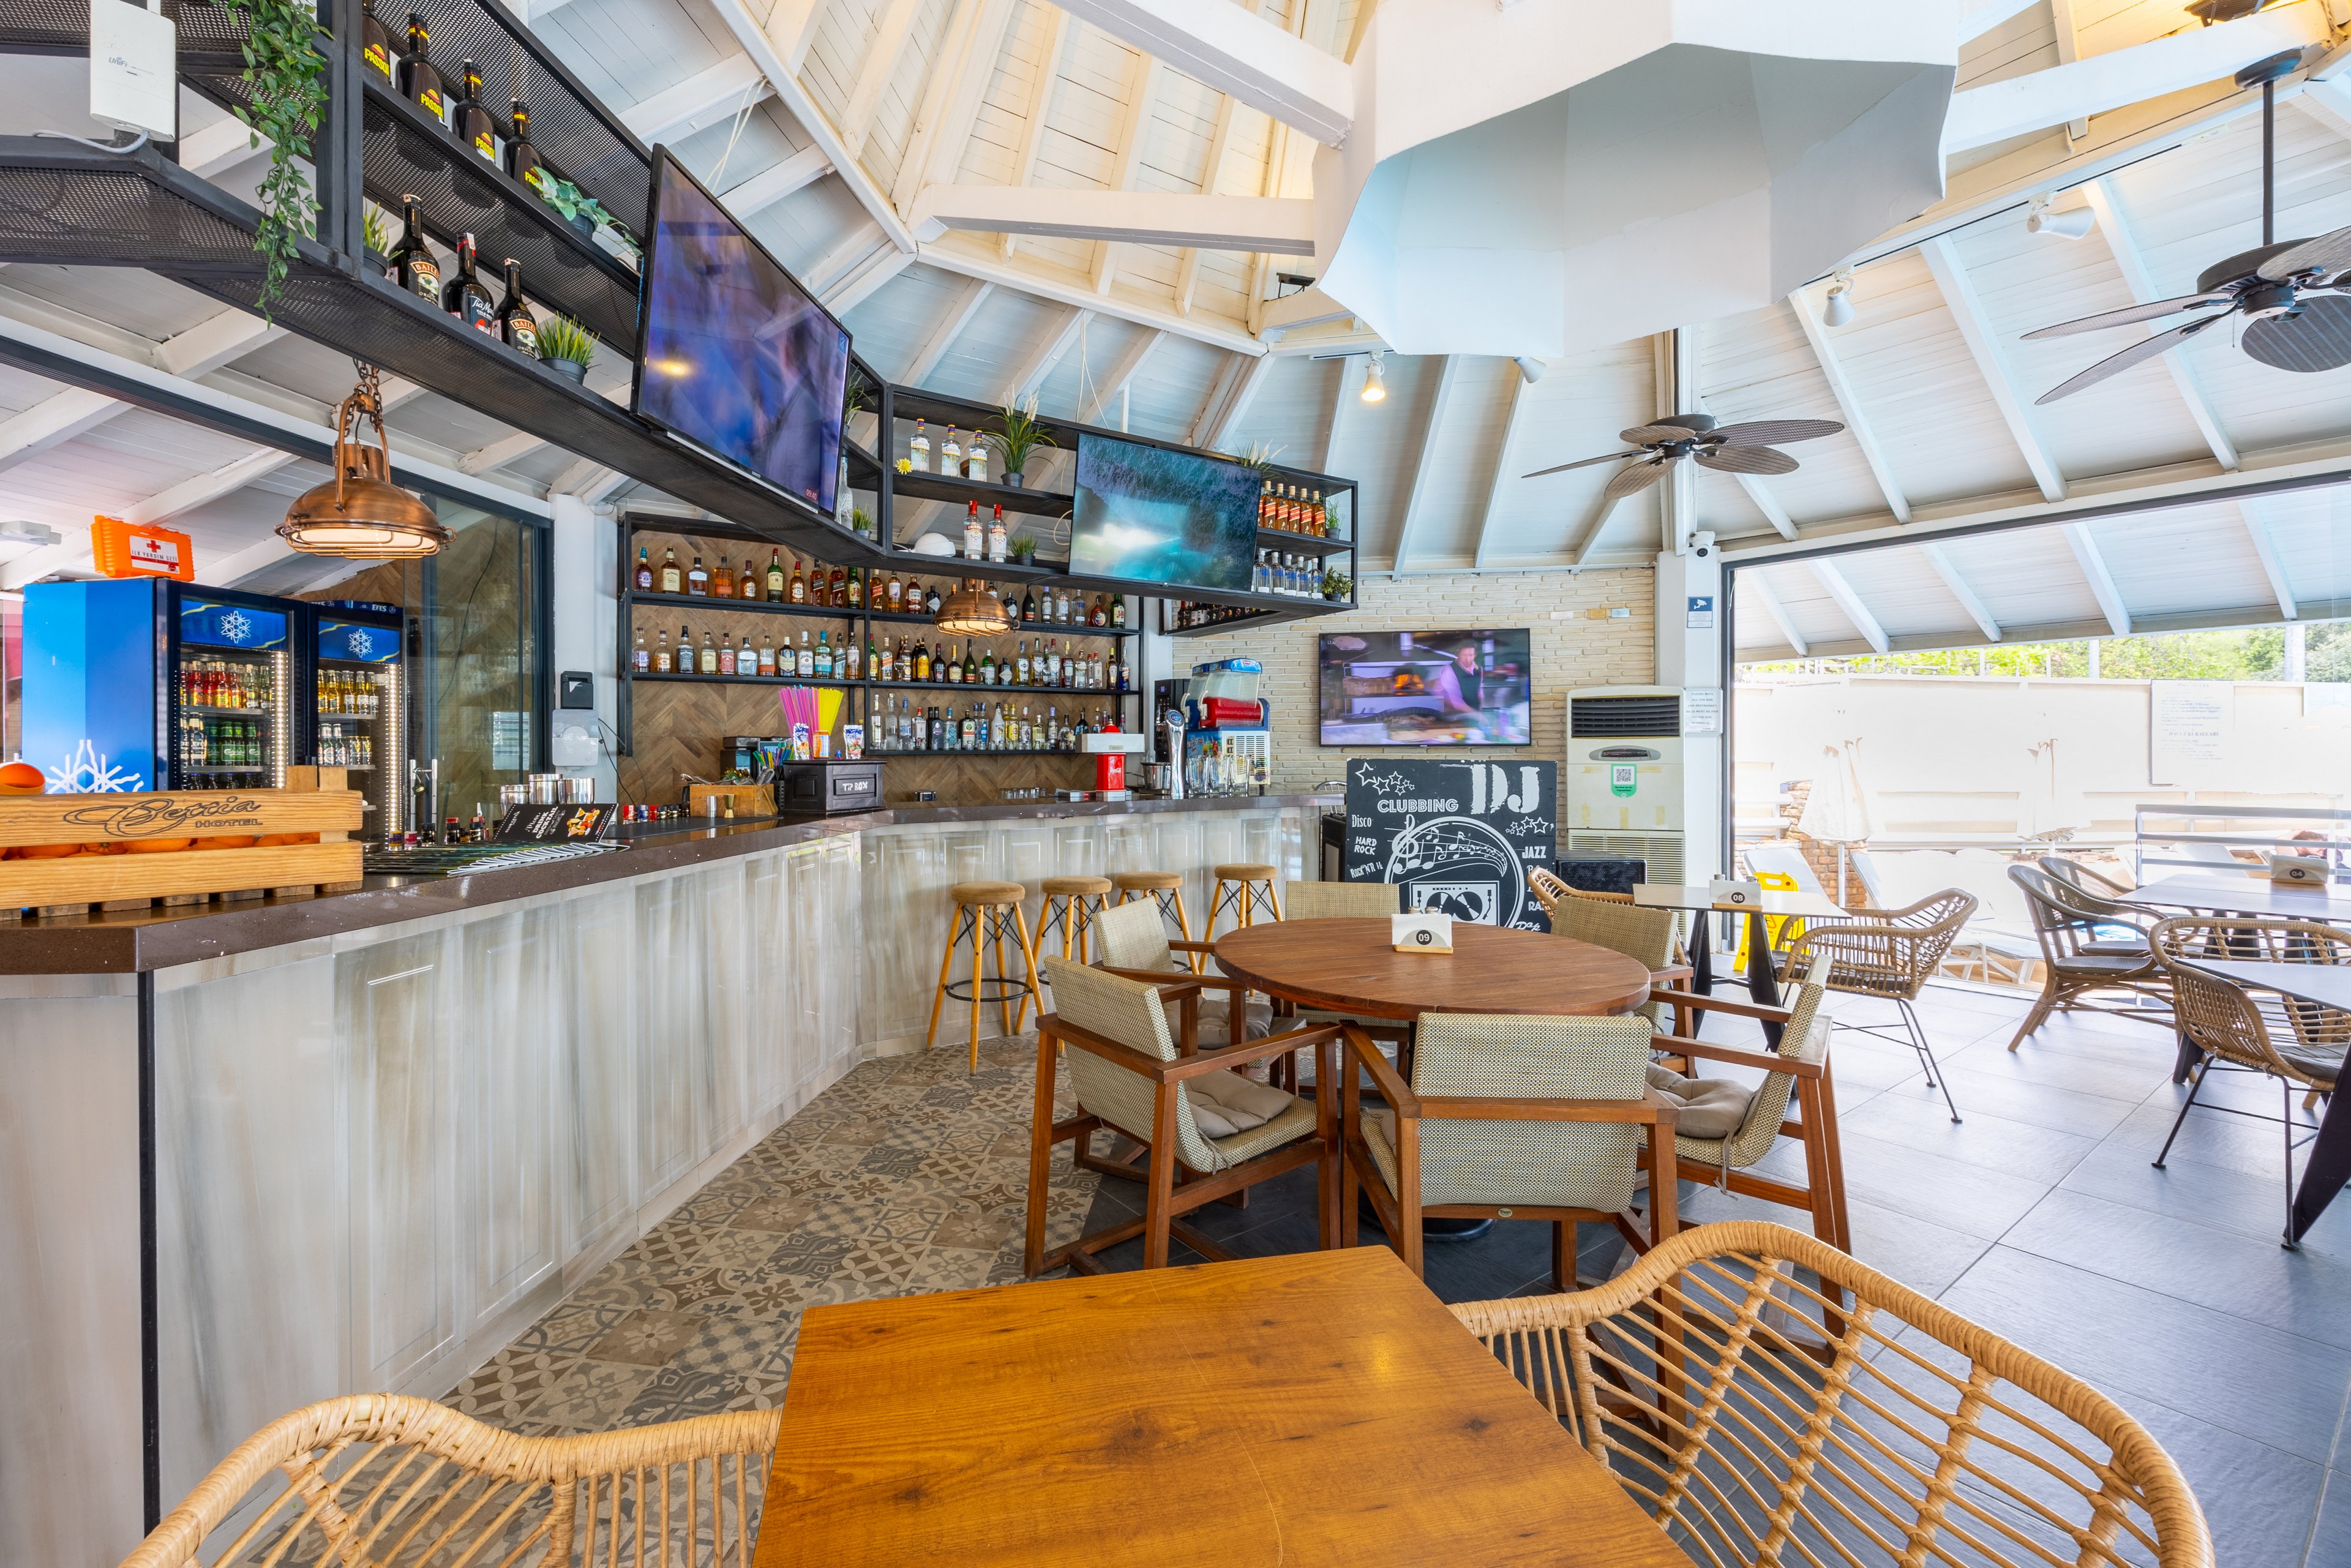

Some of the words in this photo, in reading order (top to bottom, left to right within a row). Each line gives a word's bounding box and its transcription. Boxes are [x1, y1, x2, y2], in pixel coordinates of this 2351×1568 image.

[108, 57, 127, 67] UniFi
[471, 299, 483, 308] Tia
[806, 489, 817, 500] 09:40
[855, 781, 868, 791] BOX
[1471, 764, 1540, 814] DJ
[1378, 798, 1459, 812] CLUBBING
[195, 819, 263, 828] HOTEL
[532, 811, 549, 833] DRINK
[536, 806, 558, 839] COCKTAIL
[1355, 836, 1377, 846] HARD
[1354, 845, 1376, 855] ROCK
[1522, 846, 1547, 858] JAZZ
[1528, 901, 1544, 911] RA
